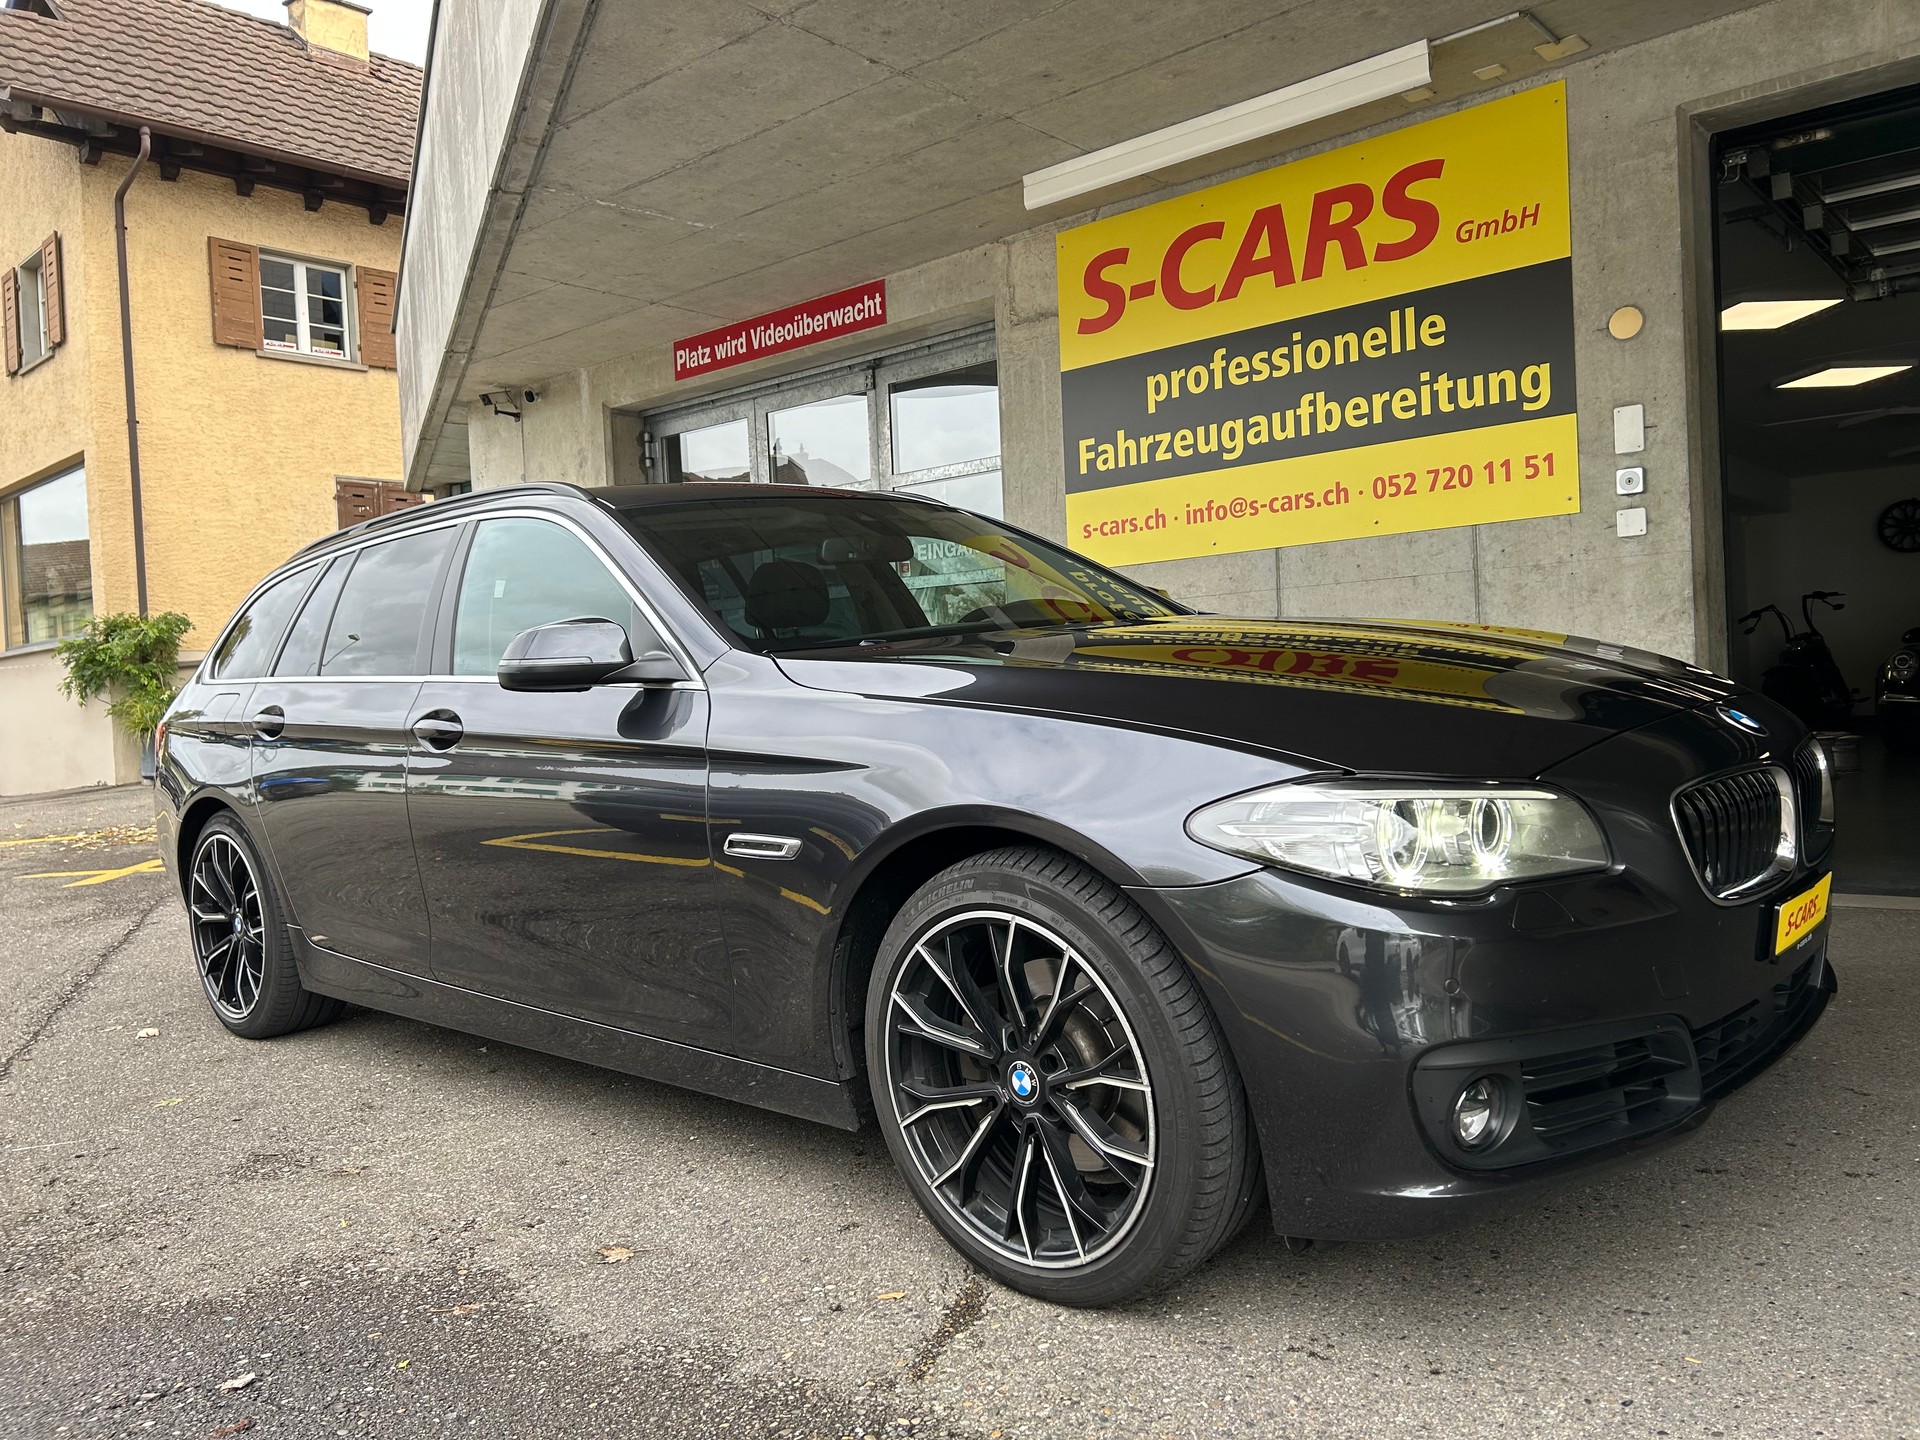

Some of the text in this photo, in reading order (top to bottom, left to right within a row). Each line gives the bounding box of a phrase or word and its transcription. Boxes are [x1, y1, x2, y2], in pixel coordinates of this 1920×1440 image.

[1077, 158, 1540, 334] S-CARS GmbH
[676, 293, 882, 371] Platz wird Videoüberwacht
[1146, 306, 1446, 414] professionelle
[1078, 362, 1551, 474] Fahrzeugaufbereitung
[1083, 452, 1555, 539] s-cars.ch info@s-cars.ch 052 720 11 51
[1785, 894, 1819, 937] S-CARS
[1016, 1063, 1037, 1087] BMW
